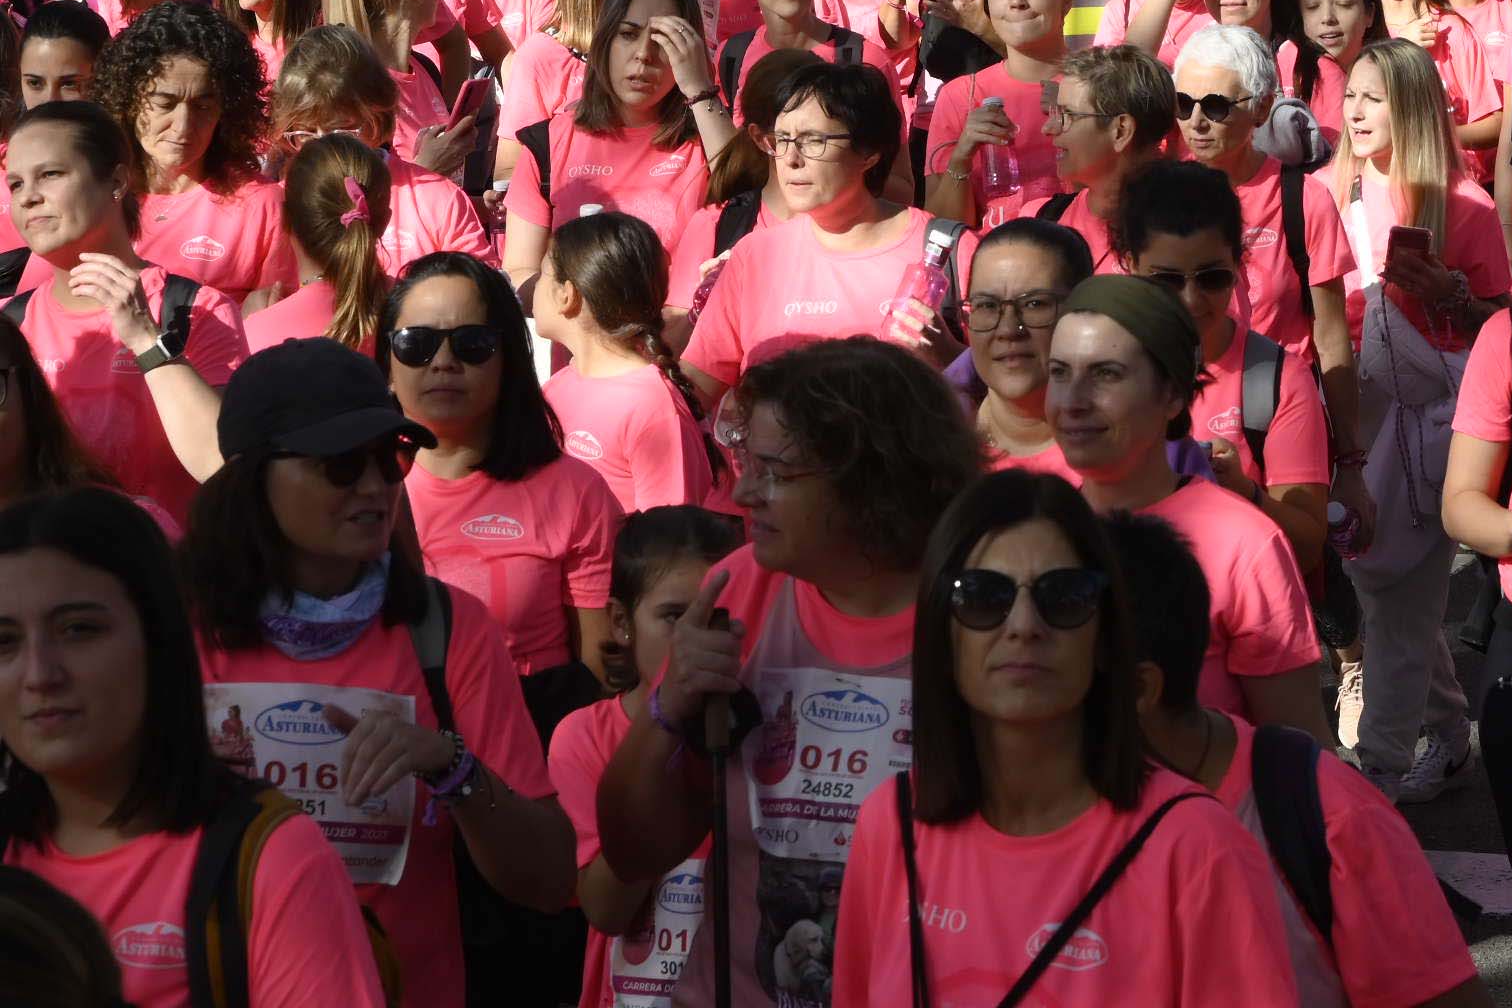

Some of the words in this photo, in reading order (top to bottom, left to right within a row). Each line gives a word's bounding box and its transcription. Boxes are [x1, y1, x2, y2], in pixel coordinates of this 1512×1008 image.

[569, 165, 613, 178] OYSHO
[784, 300, 838, 316] OYSHO
[466, 522, 518, 537] ASTURIANA
[803, 698, 881, 726] ASTURIANA
[262, 713, 343, 735] ASTURIAN
[800, 744, 869, 774] 016
[264, 760, 339, 790] 016
[801, 779, 854, 799] 24852
[820, 805, 837, 816] LA
[764, 829, 798, 844] SHO
[661, 884, 703, 904] ASTURIA
[658, 928, 689, 953] 01
[623, 980, 662, 992] CARRERA
